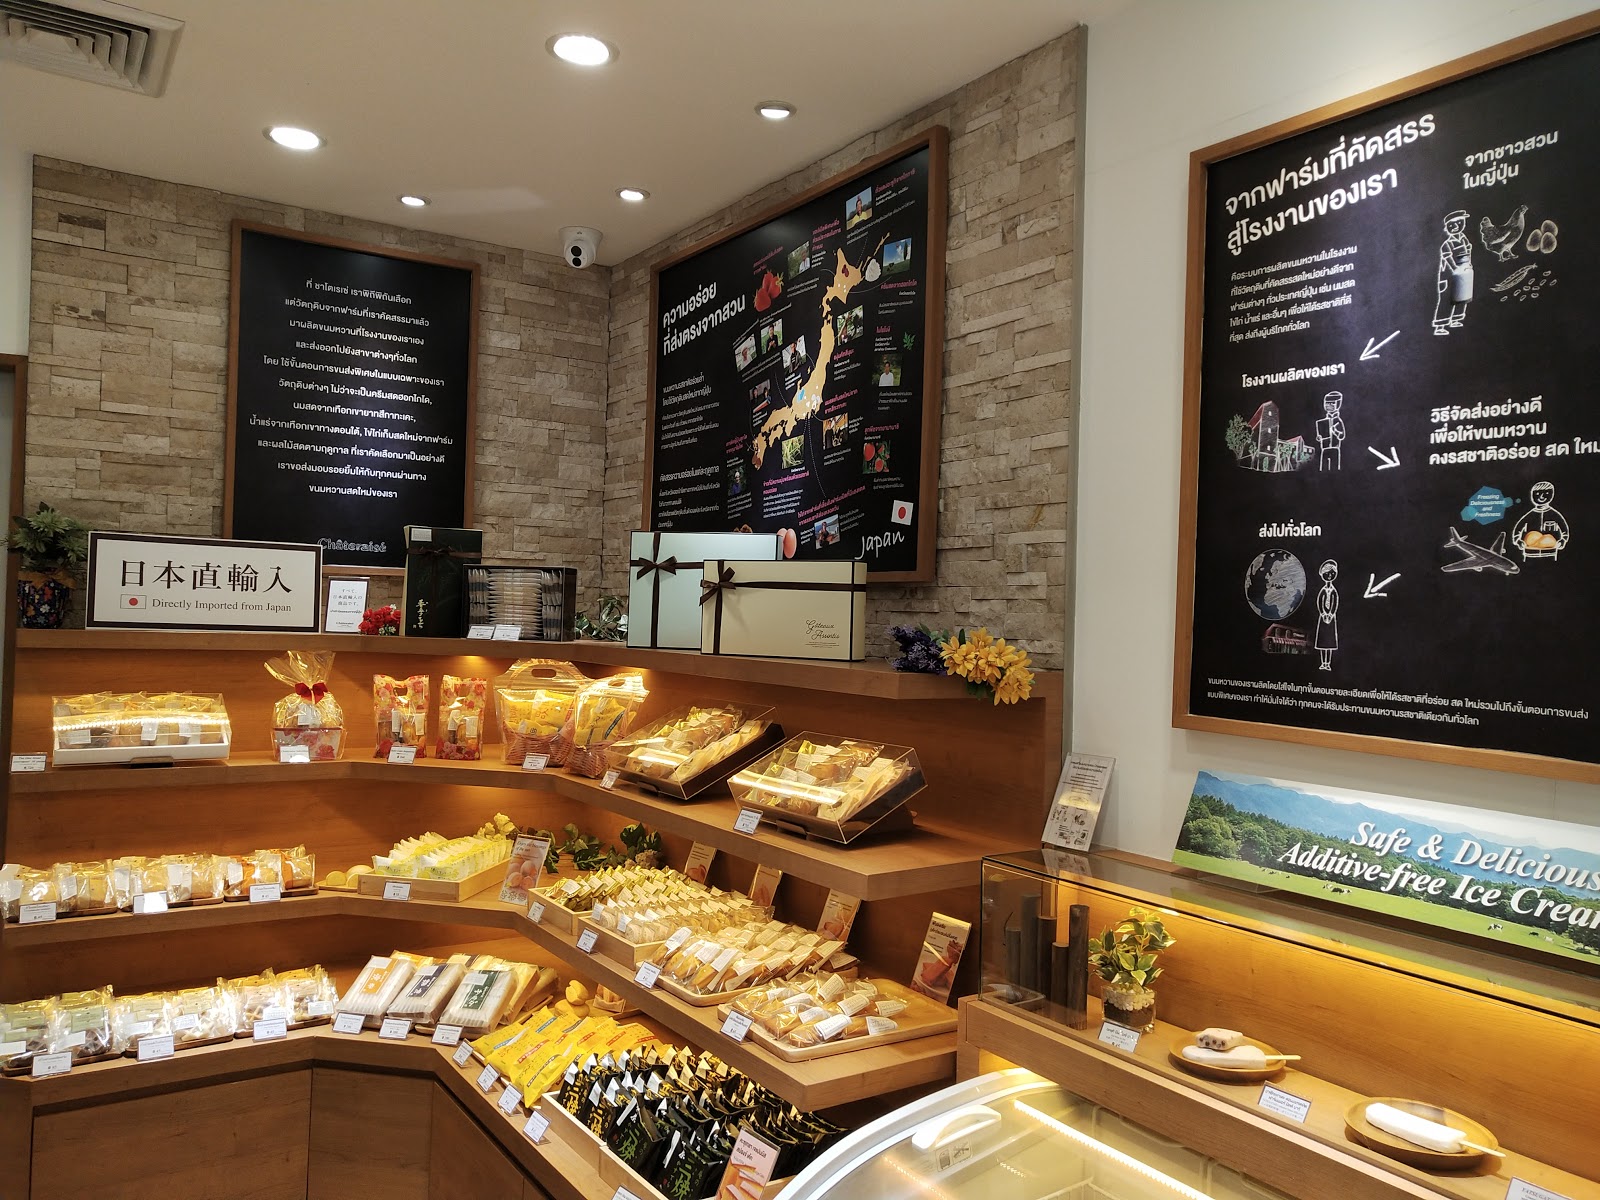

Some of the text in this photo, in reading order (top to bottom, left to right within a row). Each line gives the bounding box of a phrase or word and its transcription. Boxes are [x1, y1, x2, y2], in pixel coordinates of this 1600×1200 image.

[1226, 114, 1435, 214] จากฟาร์มที่คัดสรร
[1465, 131, 1558, 166] จากชาวสวน
[1463, 162, 1518, 189] ในญี่ปุ่น
[1228, 168, 1398, 255] สู่โรงงานของเรา
[663, 282, 717, 328] ความอร่อย
[663, 294, 746, 356] ที่ส่งตรงจากสวน
[264, 355, 278, 365] โดย
[1242, 363, 1345, 387] โรงงานผลิตของเรา
[1431, 396, 1542, 425] วิธีจัดส่งอย่างดี
[1430, 422, 1546, 444] เพื่อให้ขนมหวาน
[1430, 442, 1540, 464] คงรสชาติอร่อย
[1545, 443, 1569, 456] สด
[1259, 519, 1321, 537] ส่งไปทั่วโลก
[121, 560, 292, 593] 日本直輸入
[152, 598, 292, 612] Directly Imported from Japan
[1350, 822, 1600, 891] Safe & Delicious
[1277, 842, 1446, 895] Additive-free
[1450, 874, 1502, 906] Ice
